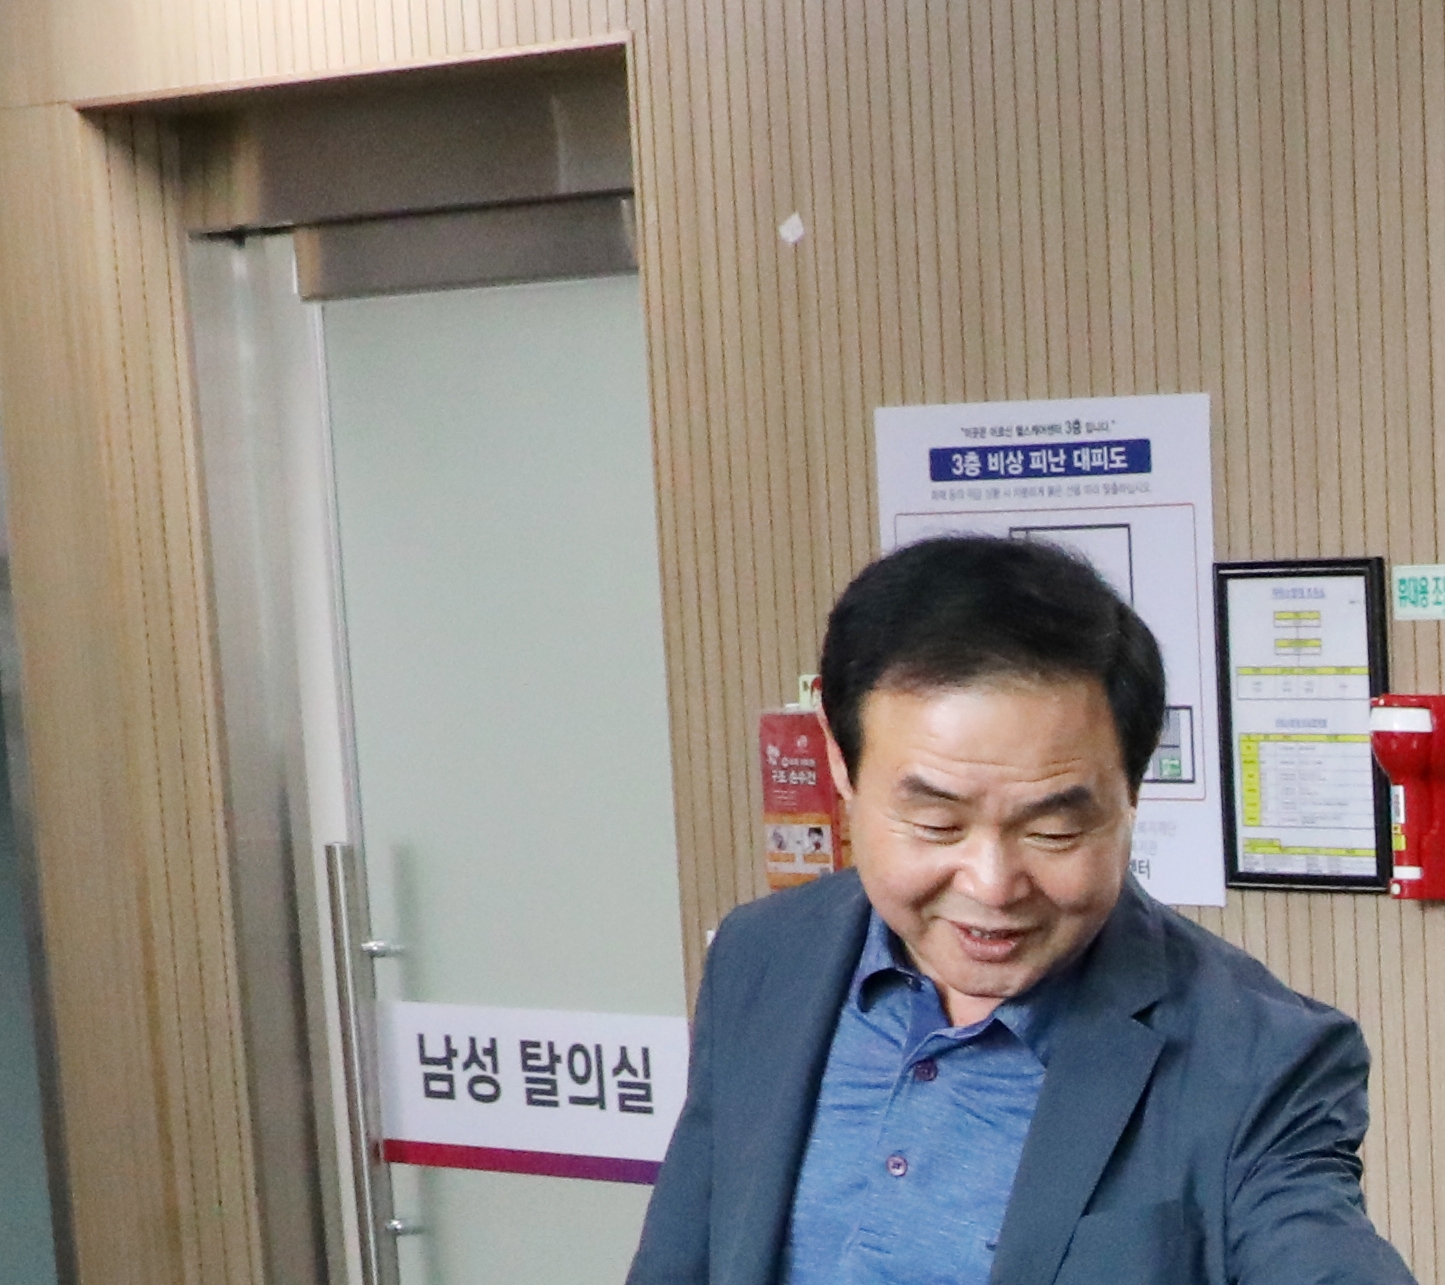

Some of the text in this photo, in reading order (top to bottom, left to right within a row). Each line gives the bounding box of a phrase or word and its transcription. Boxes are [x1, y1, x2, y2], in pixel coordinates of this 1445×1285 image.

[951, 446, 1128, 478] 3층 비상 피난 대피도
[1398, 576, 1429, 609] 휴대용
[417, 1032, 655, 1115] 남성 탈의실
